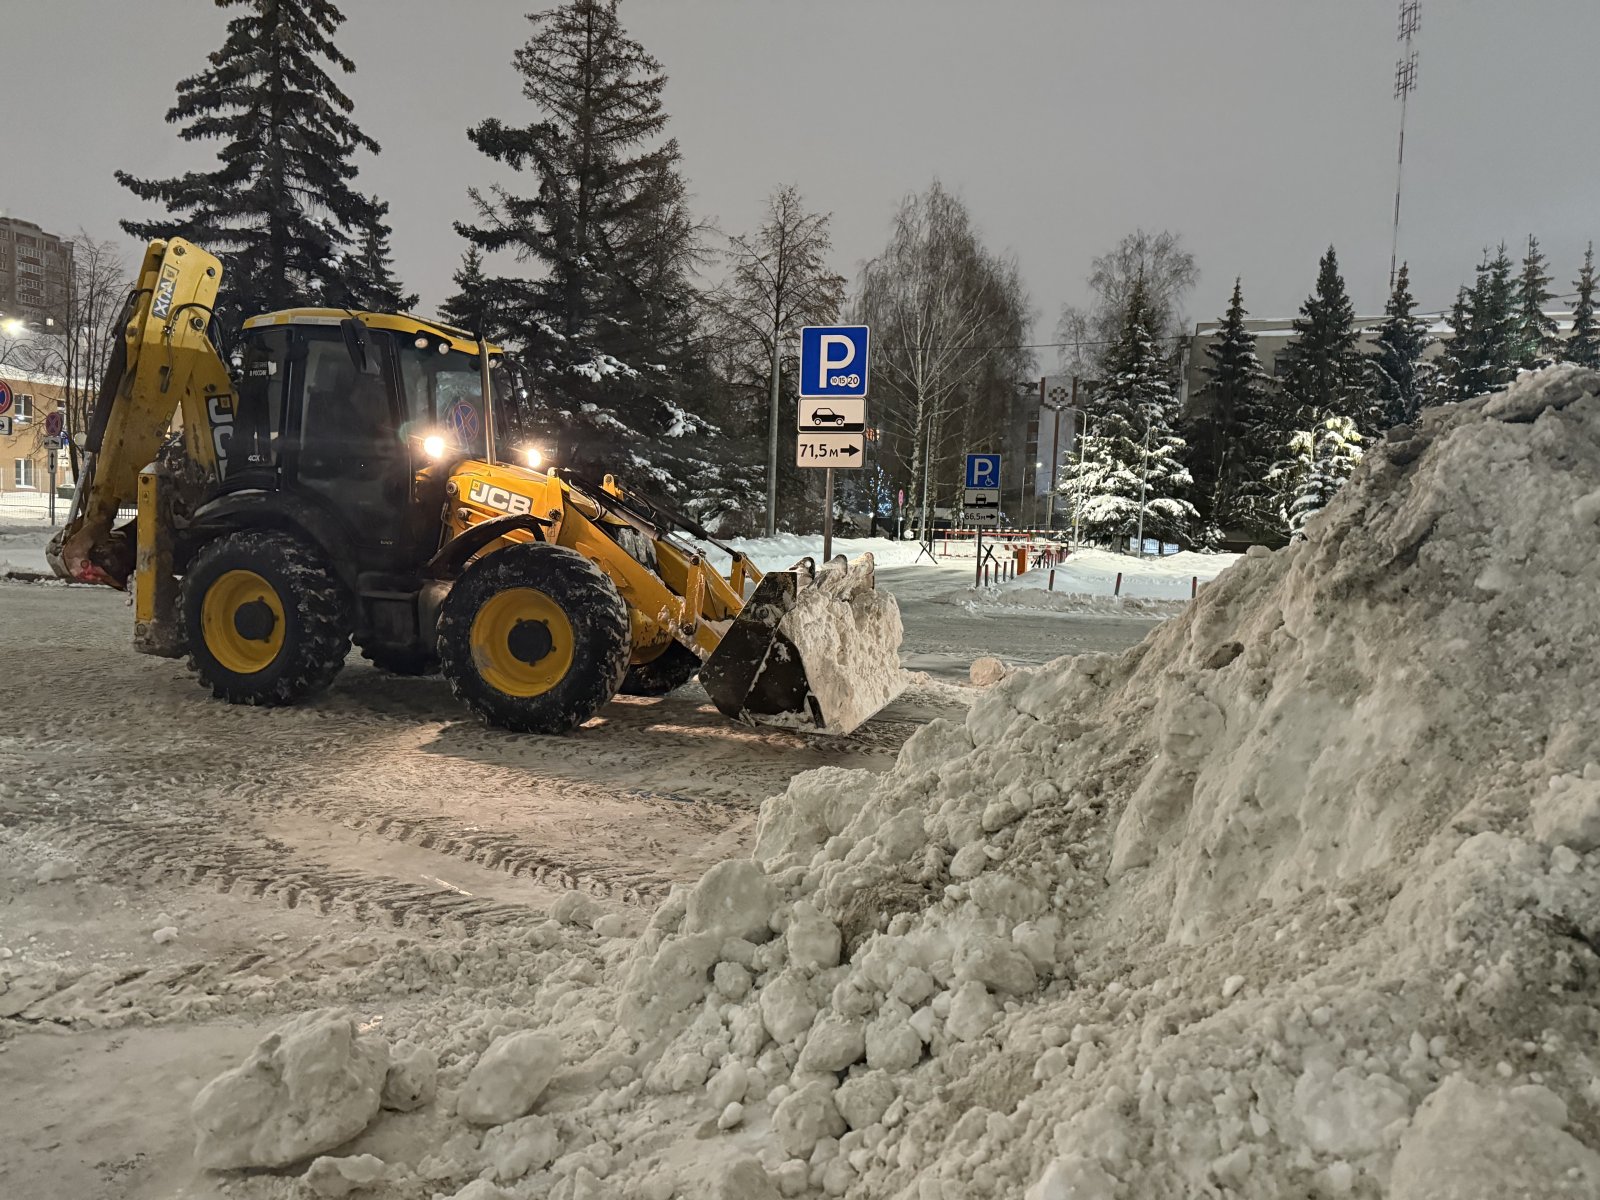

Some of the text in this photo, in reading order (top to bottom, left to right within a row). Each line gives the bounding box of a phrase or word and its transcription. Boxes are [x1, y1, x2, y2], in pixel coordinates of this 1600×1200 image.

[819, 334, 856, 389] P
[847, 376, 859, 385] 20
[208, 397, 234, 481] JC
[973, 458, 993, 485] P
[470, 483, 531, 515] JCB
